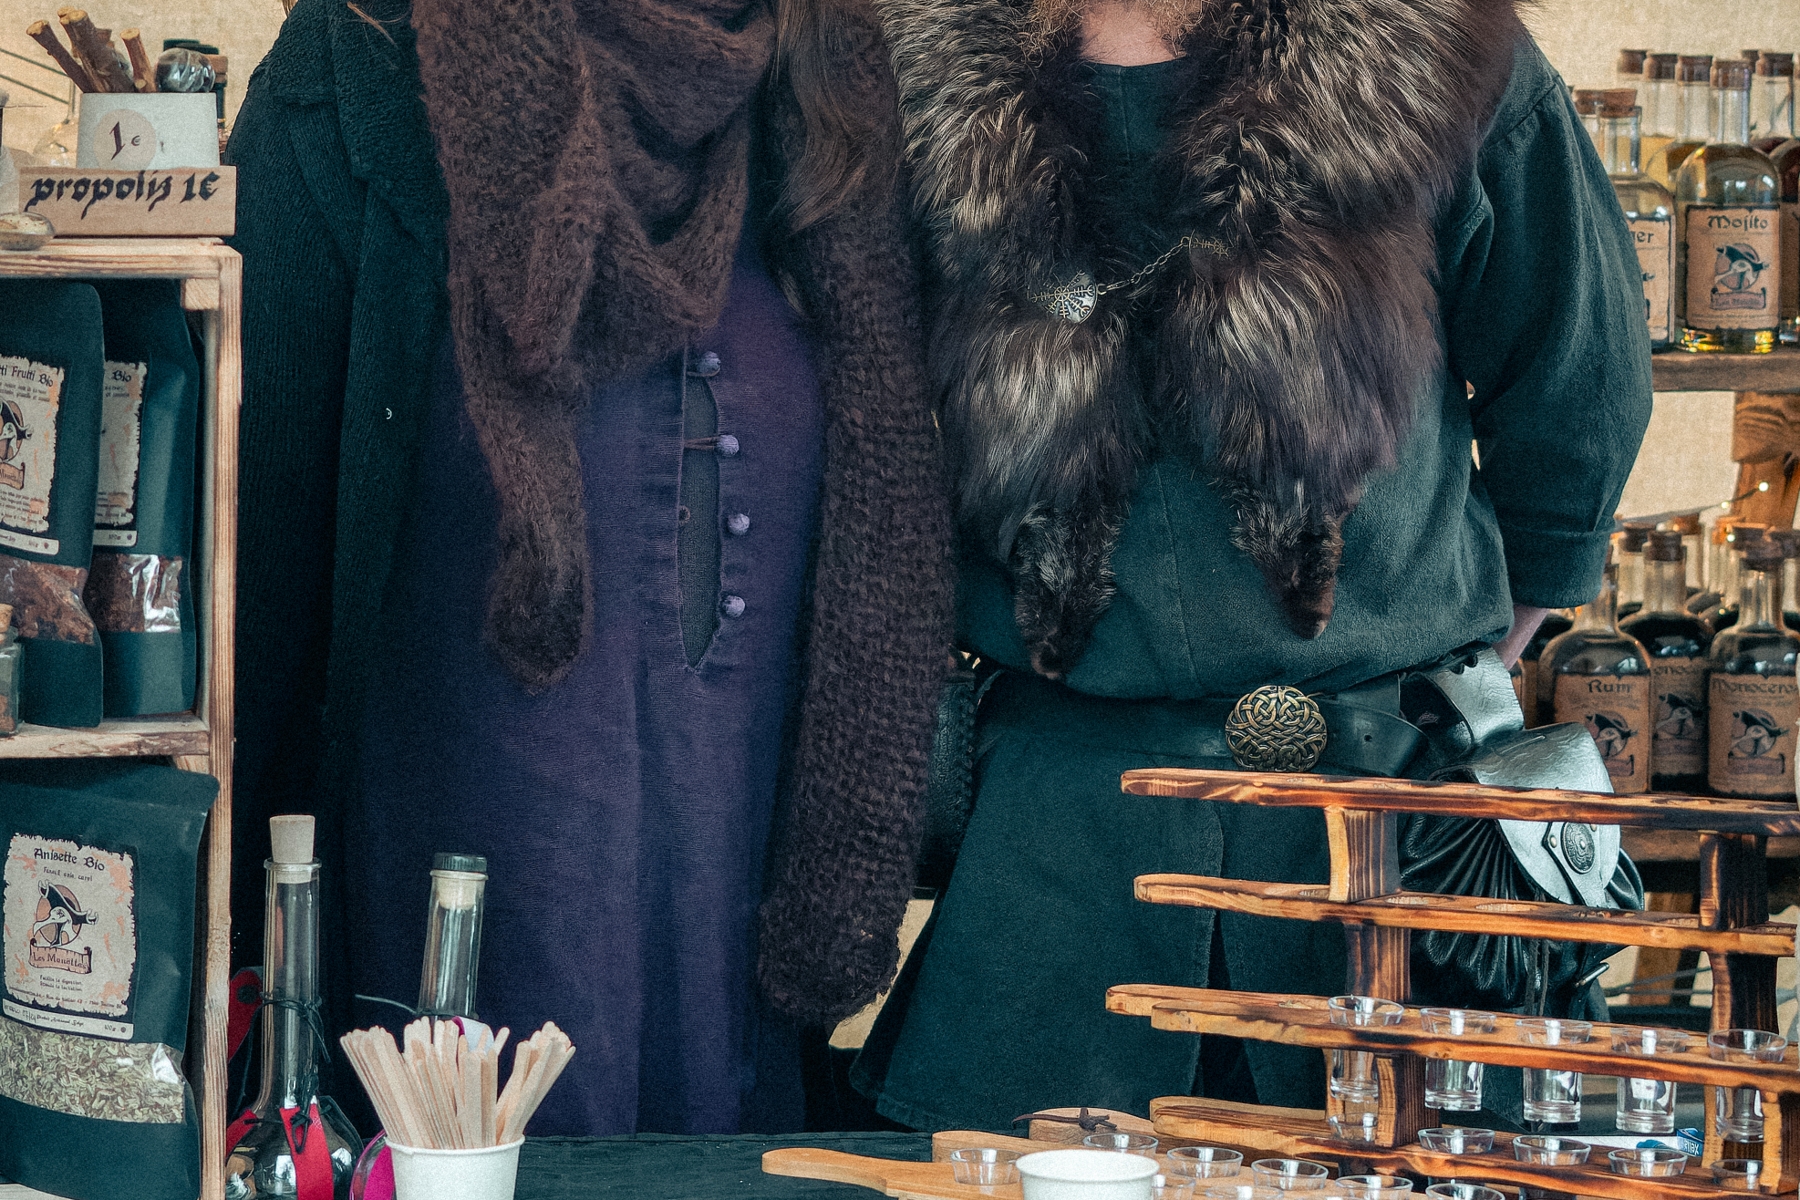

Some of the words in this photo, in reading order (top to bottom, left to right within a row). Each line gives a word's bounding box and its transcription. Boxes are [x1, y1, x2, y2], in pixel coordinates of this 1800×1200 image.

[23, 169, 173, 220] propolis
[1707, 214, 1769, 231] Mojito
[38, 373, 54, 387] Bio
[112, 369, 132, 382] Bio
[1587, 678, 1633, 693] Rum
[34, 847, 78, 864] Anisette
[84, 856, 105, 871] Bio
